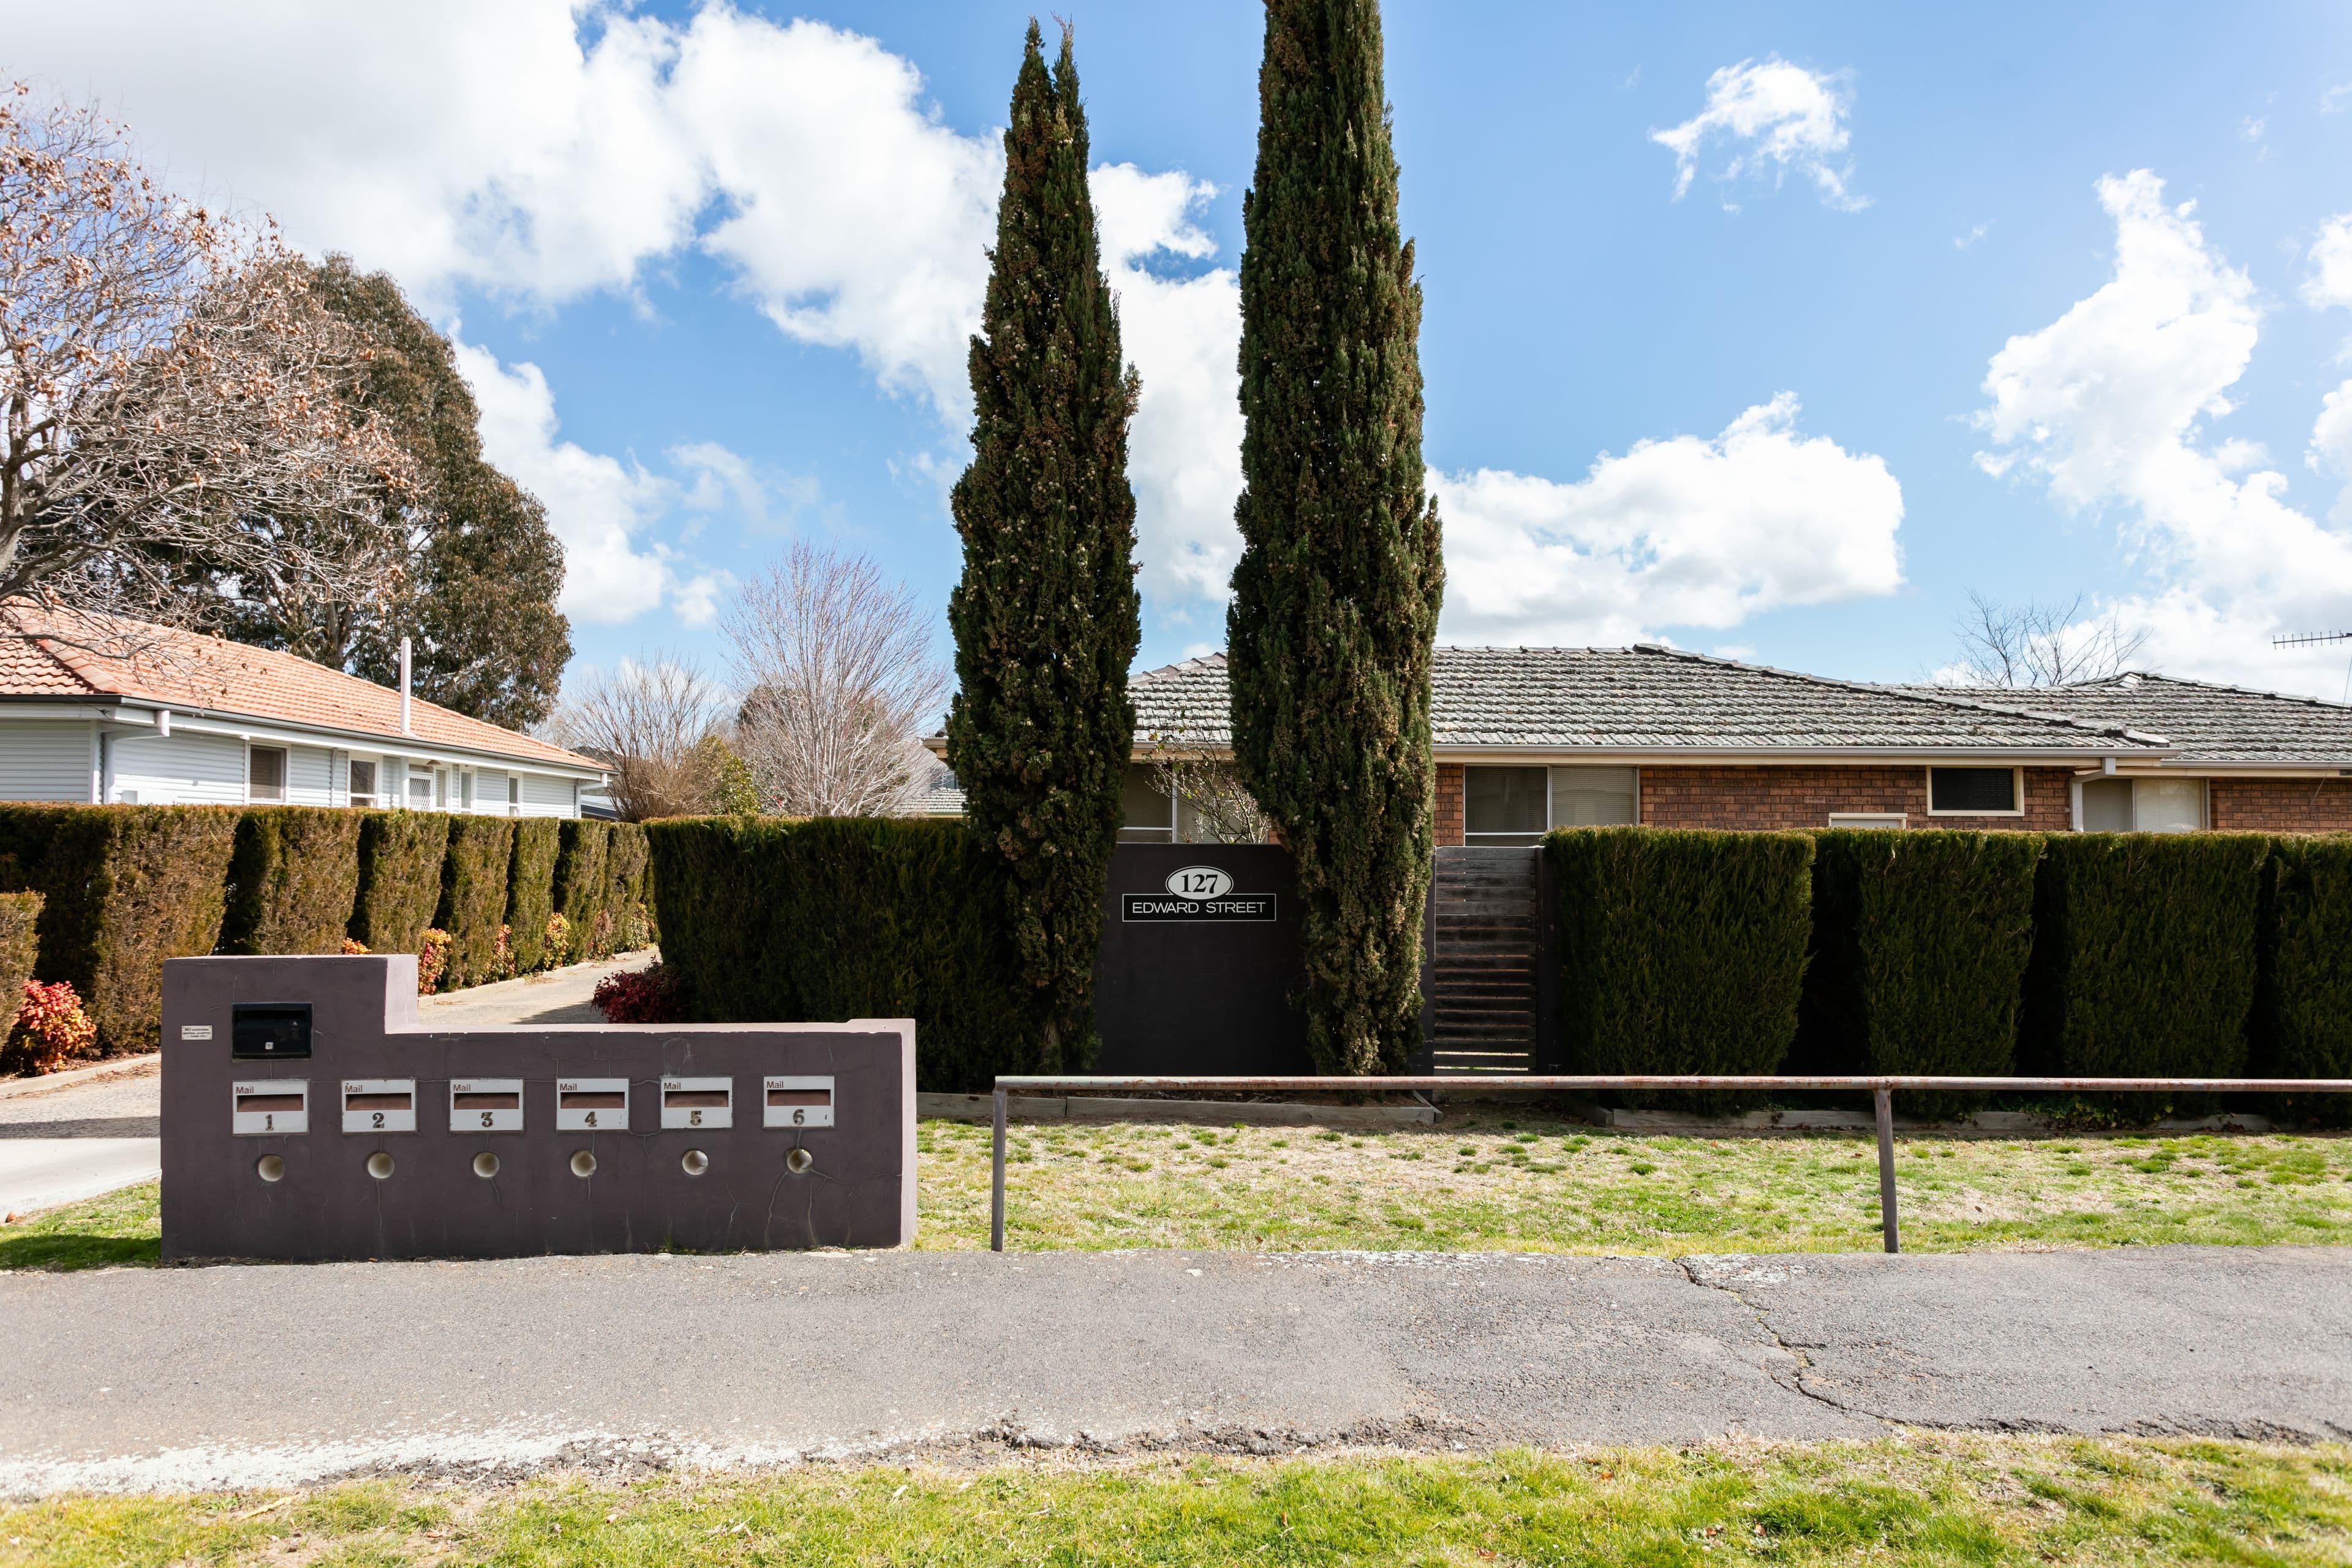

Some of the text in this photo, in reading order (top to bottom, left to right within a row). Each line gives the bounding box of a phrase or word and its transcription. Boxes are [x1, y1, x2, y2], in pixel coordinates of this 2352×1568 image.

[1181, 873, 1218, 894] 127
[1133, 902, 1266, 913] EDWARD STREET
[265, 1114, 274, 1131] 1
[372, 1112, 385, 1129] 2
[480, 1112, 494, 1128] 3
[584, 1111, 597, 1128] 4
[690, 1110, 702, 1126] 5
[793, 1109, 805, 1125] 6
